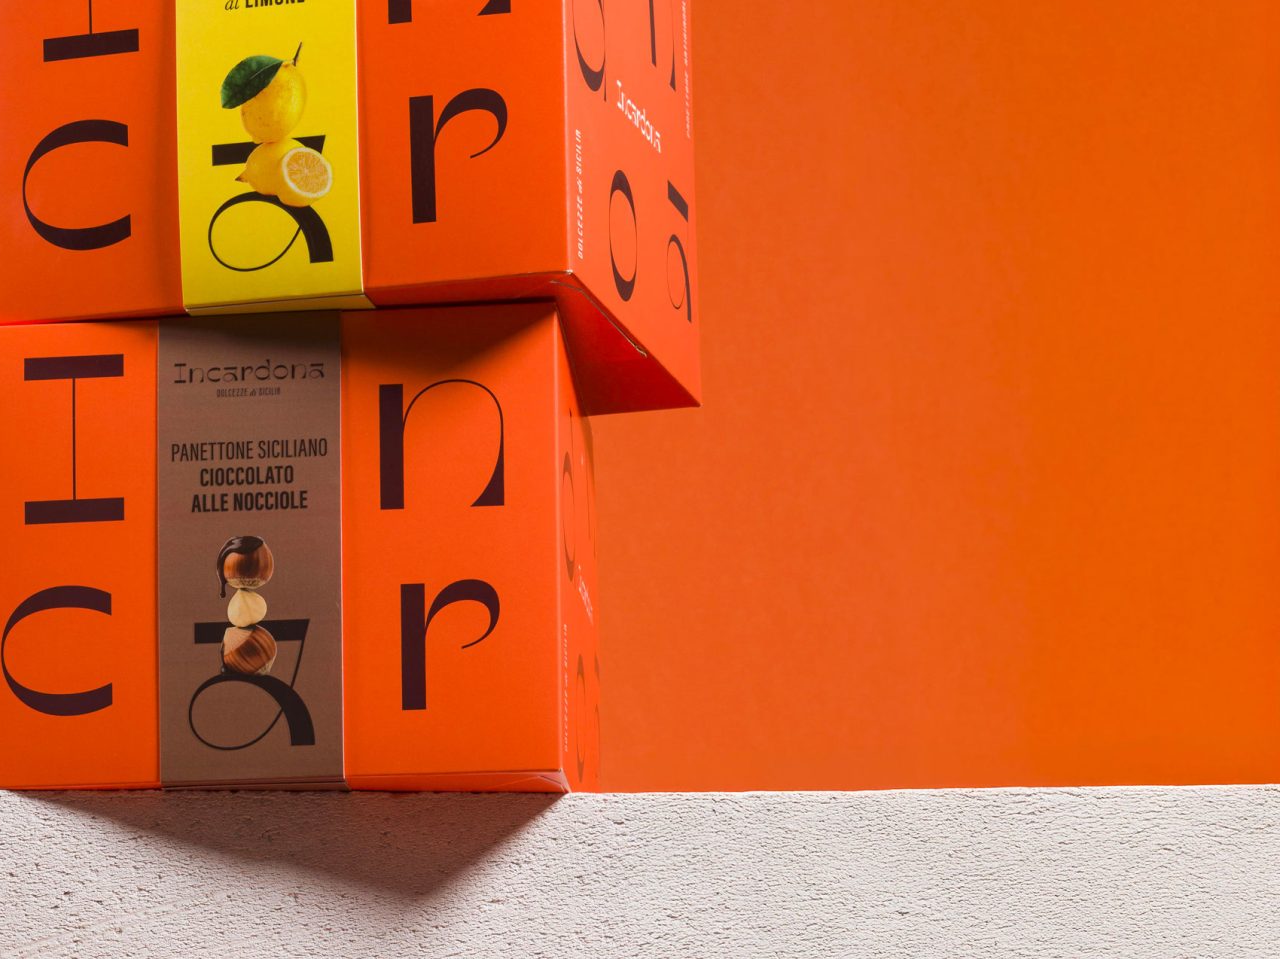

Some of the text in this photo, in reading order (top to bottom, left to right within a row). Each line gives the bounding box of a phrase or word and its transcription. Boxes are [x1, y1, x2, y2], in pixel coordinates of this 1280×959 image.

[174, 359, 325, 383] Incardona
[217, 389, 248, 397] DOLCEZZE
[259, 387, 281, 395] SICILIA
[171, 438, 328, 462] PANETTONE SICILIANO
[200, 465, 294, 487] CIOCCOLATO
[192, 491, 308, 512] ALLE NOCCIOLE
